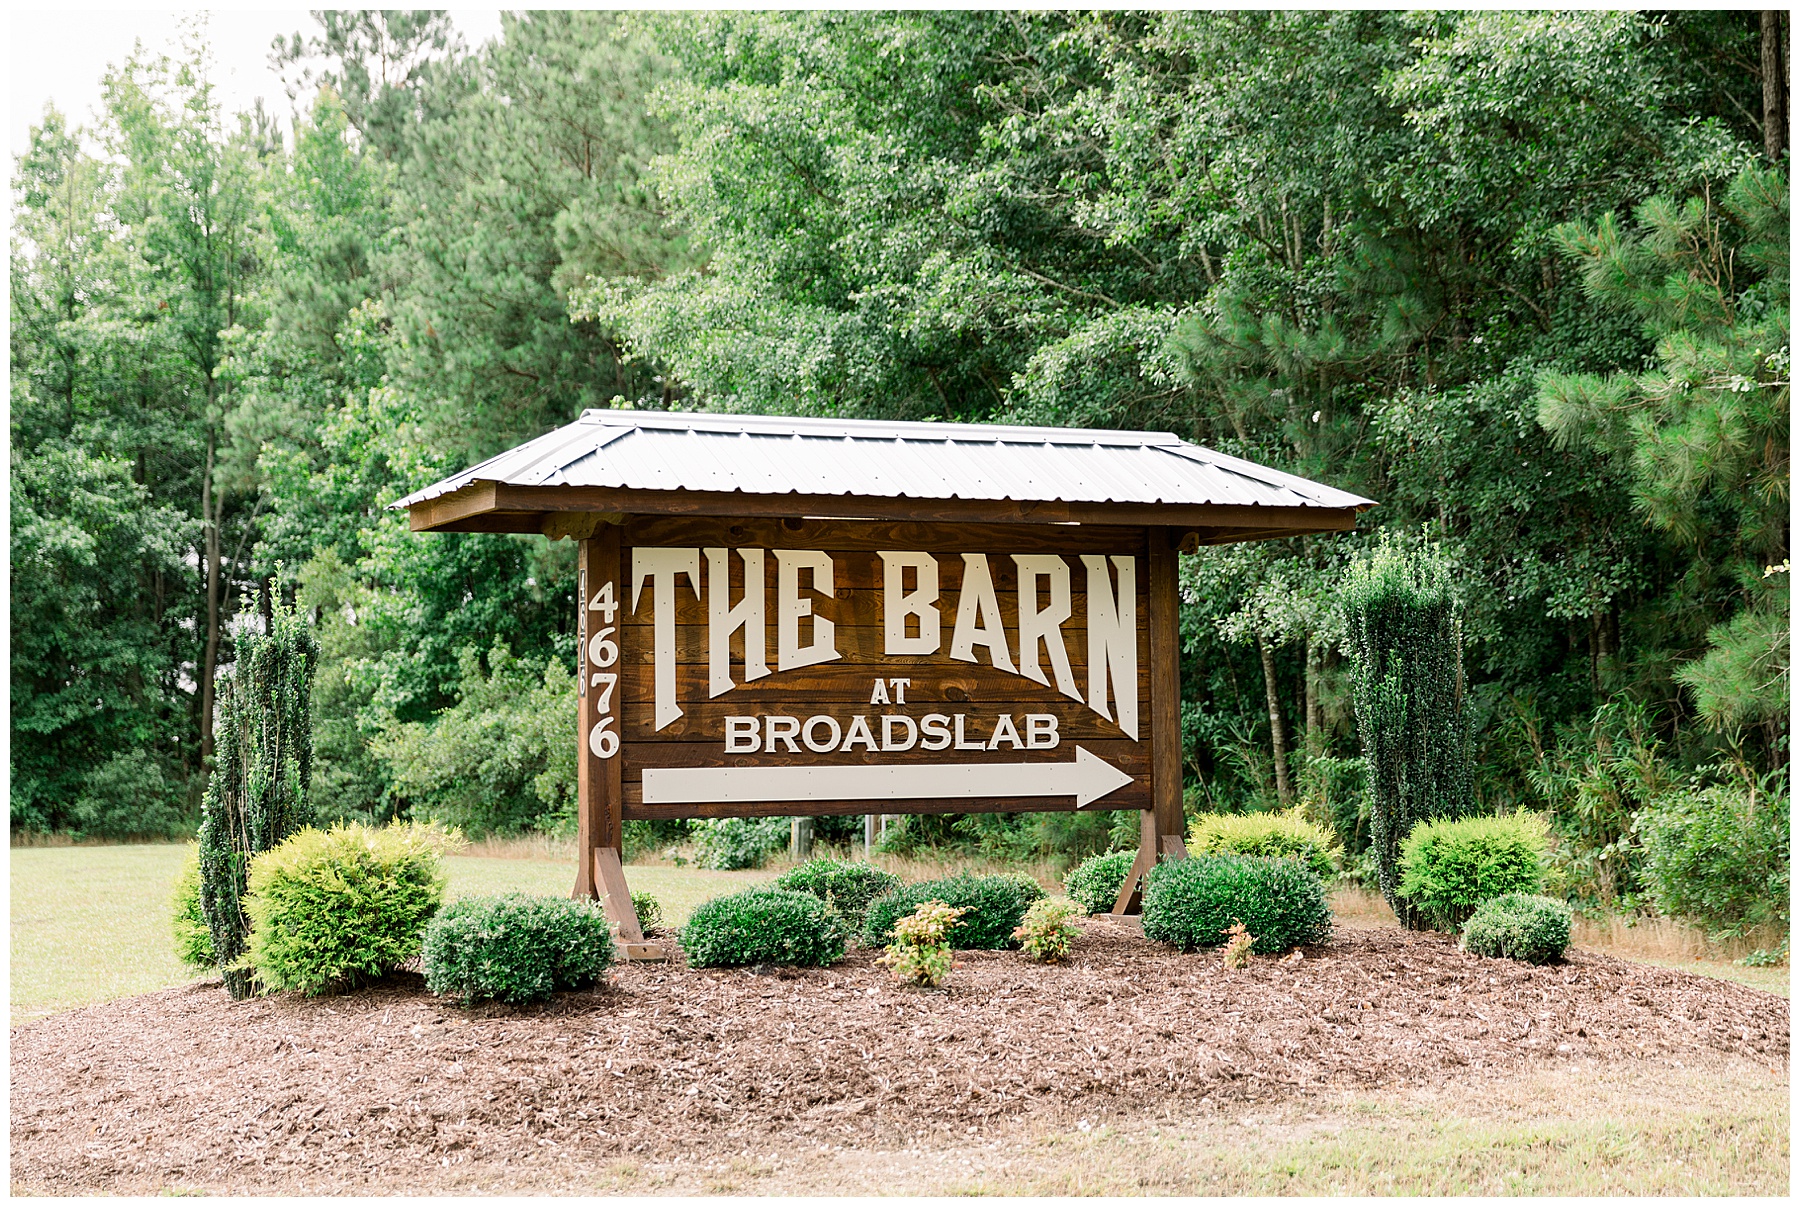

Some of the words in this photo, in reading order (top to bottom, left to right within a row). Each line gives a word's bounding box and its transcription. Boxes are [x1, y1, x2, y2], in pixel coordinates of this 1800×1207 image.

[588, 581, 619, 759] 4676
[632, 547, 842, 732] THE
[876, 551, 1139, 742] BARN
[870, 678, 911, 705] AT
[724, 713, 1060, 753] BROADSLAB
